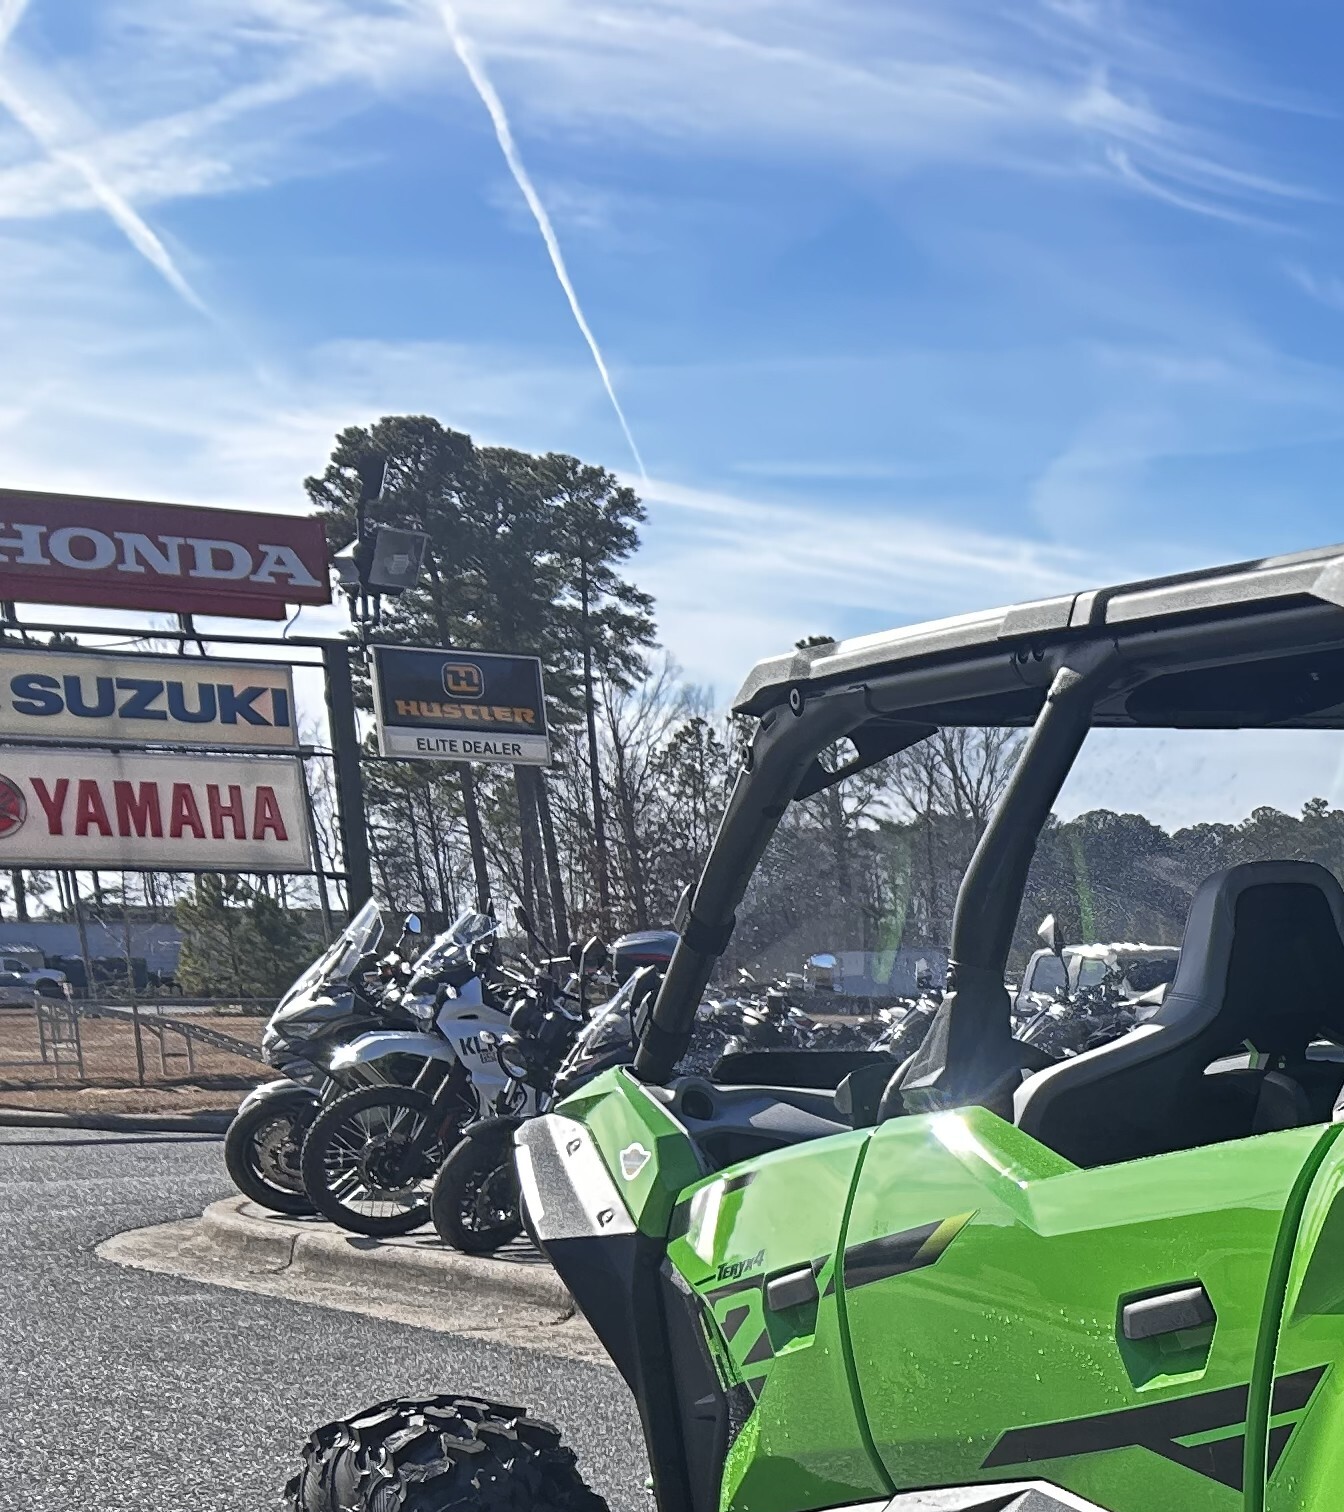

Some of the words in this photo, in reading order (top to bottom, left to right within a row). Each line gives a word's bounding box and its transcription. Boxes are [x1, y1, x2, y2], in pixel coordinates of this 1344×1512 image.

[0, 522, 323, 588] HONDA
[10, 673, 291, 728] SUZUKI
[394, 699, 537, 725] HUSTLER
[416, 737, 458, 754] ELITE
[462, 740, 523, 757] DEALER
[29, 777, 289, 842] YAMAHA
